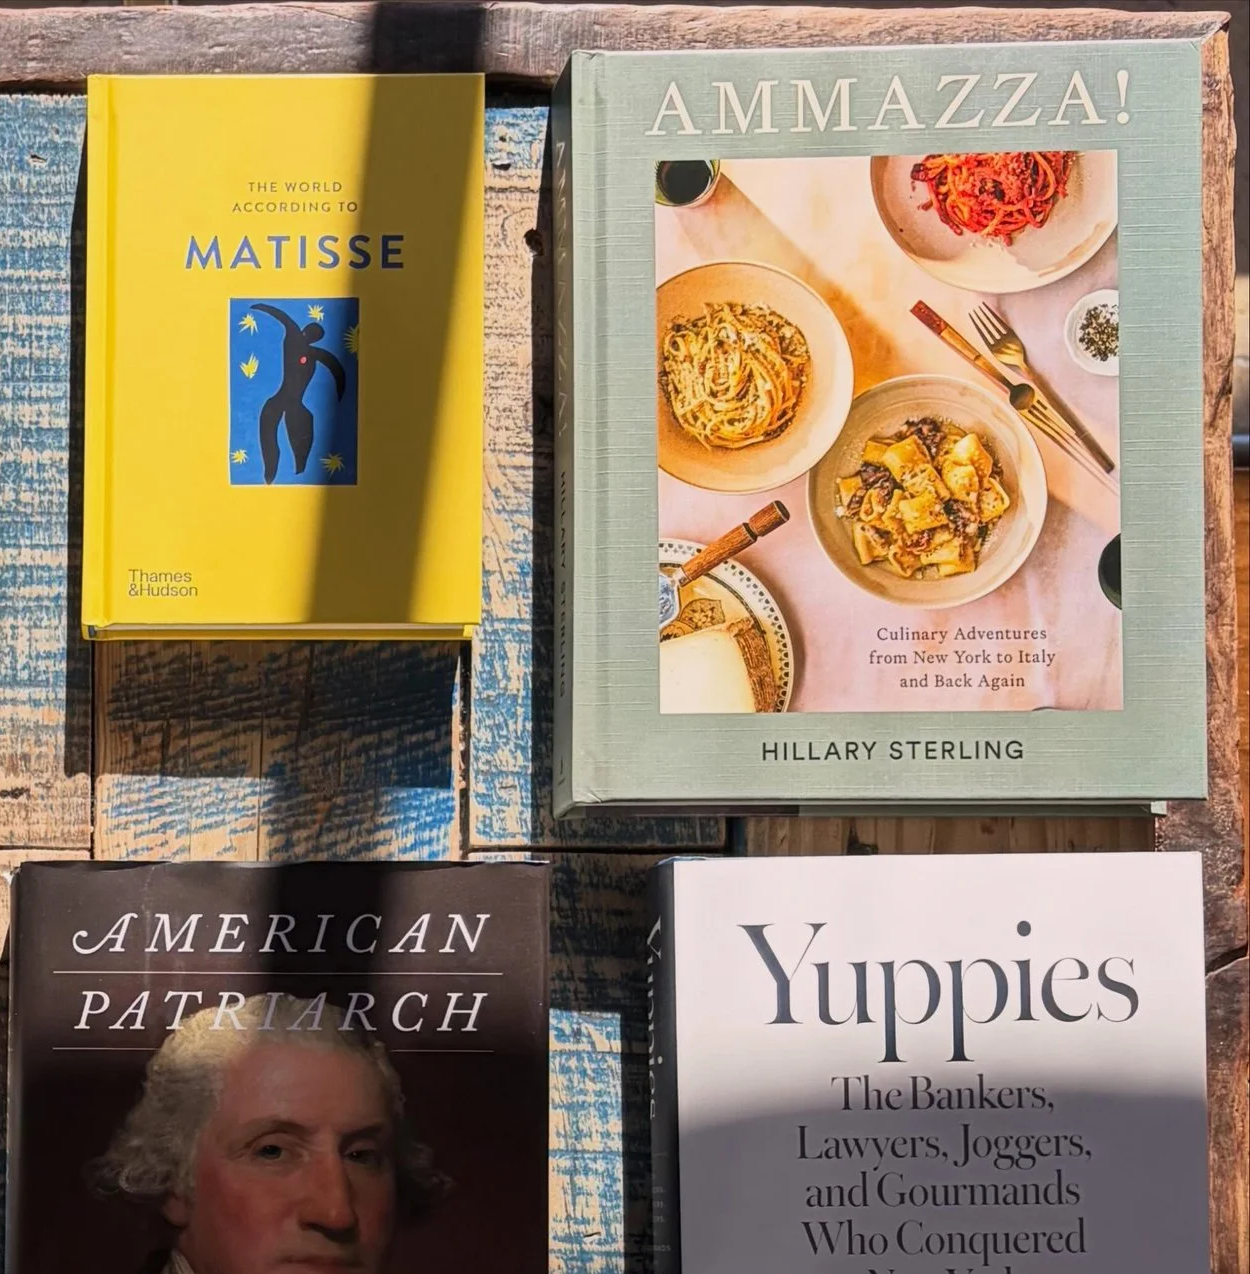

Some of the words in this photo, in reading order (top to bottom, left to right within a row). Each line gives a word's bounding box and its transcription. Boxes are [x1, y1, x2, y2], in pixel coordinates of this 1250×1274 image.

[645, 69, 1131, 136] AMMAZZA!
[248, 181, 279, 193] THE
[284, 181, 343, 193] WORLD
[231, 201, 332, 214] ACCORDING
[337, 201, 359, 213] TO
[185, 234, 405, 270] MATISSE
[128, 568, 192, 584] Thames
[128, 583, 198, 598] &Hudson
[876, 626, 947, 645] Culinary
[954, 626, 1048, 641] Adventures
[869, 649, 907, 665] from
[912, 650, 951, 664] New
[955, 649, 991, 664] York
[996, 651, 1013, 664] to
[1018, 649, 1056, 668] Italy
[899, 674, 928, 688] and
[933, 673, 972, 688] Back
[978, 674, 1026, 692] Again
[762, 741, 877, 761] HILLARY
[888, 740, 1025, 761] STERLING
[72, 912, 490, 956] AMERICAN
[737, 920, 1140, 1063] Yuppies
[74, 991, 488, 1033] PATRIARCH
[831, 1075, 903, 1111] The
[911, 1073, 1055, 1114] Bankers,
[797, 1126, 949, 1171] Lawyers,
[953, 1124, 1092, 1170] Joggers,
[805, 1171, 870, 1208] and
[876, 1170, 1081, 1207] Gourmands
[802, 1219, 889, 1256] Who
[896, 1217, 1087, 1266] Conquered
